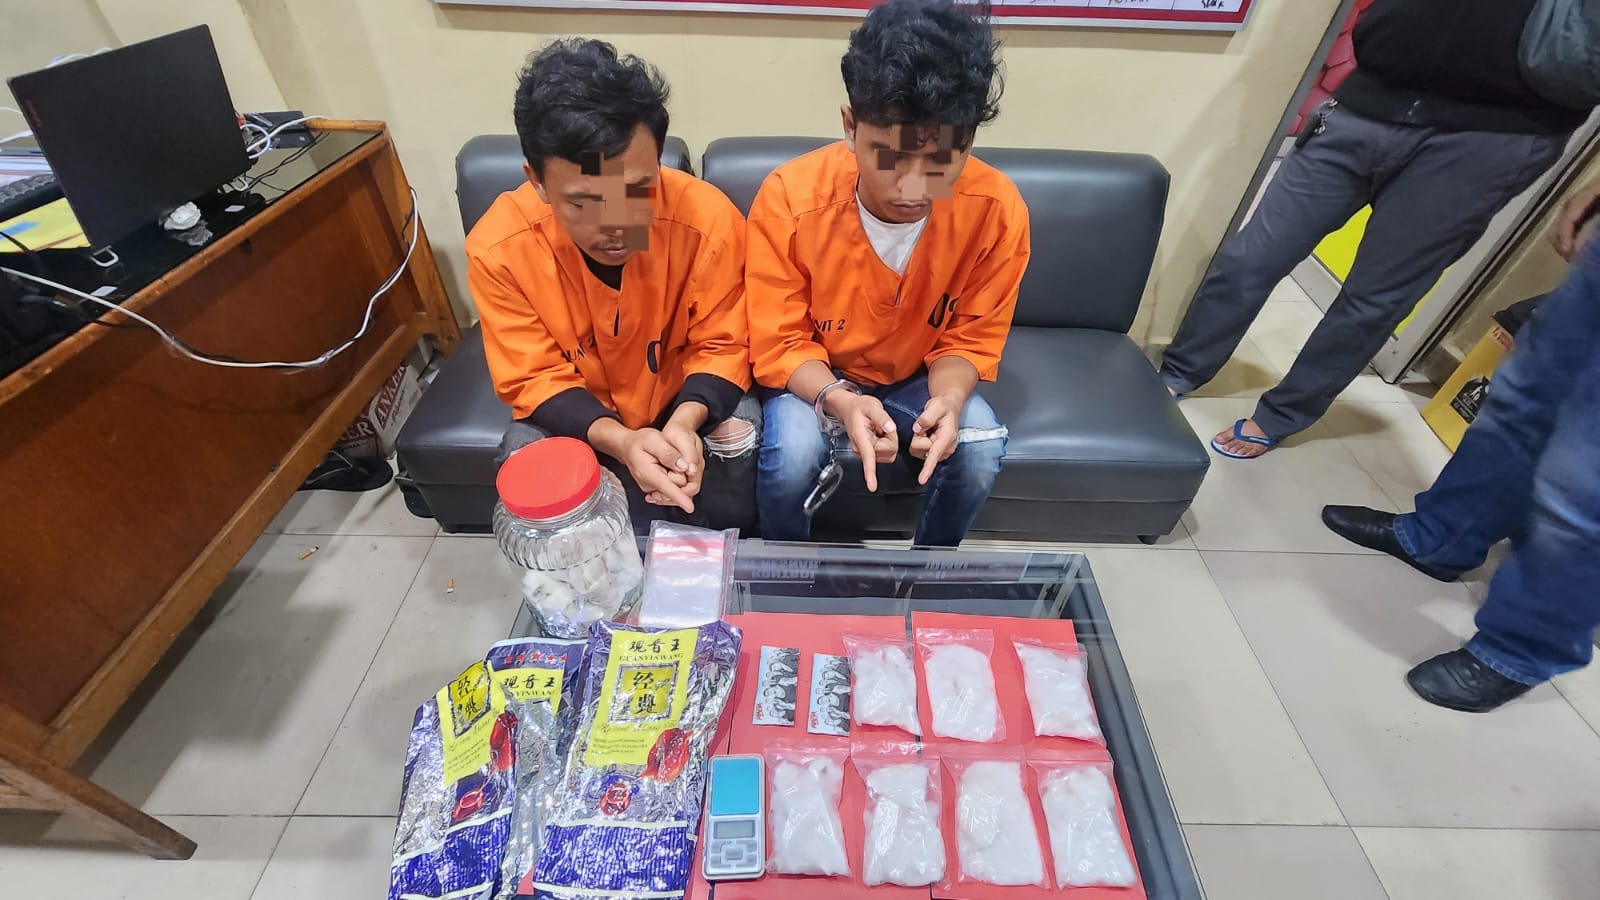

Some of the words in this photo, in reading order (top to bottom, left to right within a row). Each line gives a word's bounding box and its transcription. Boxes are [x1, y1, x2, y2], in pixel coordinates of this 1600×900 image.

[810, 316, 834, 332] NIT
[837, 319, 846, 331] 2
[619, 652, 684, 662] GUANYINWANG
